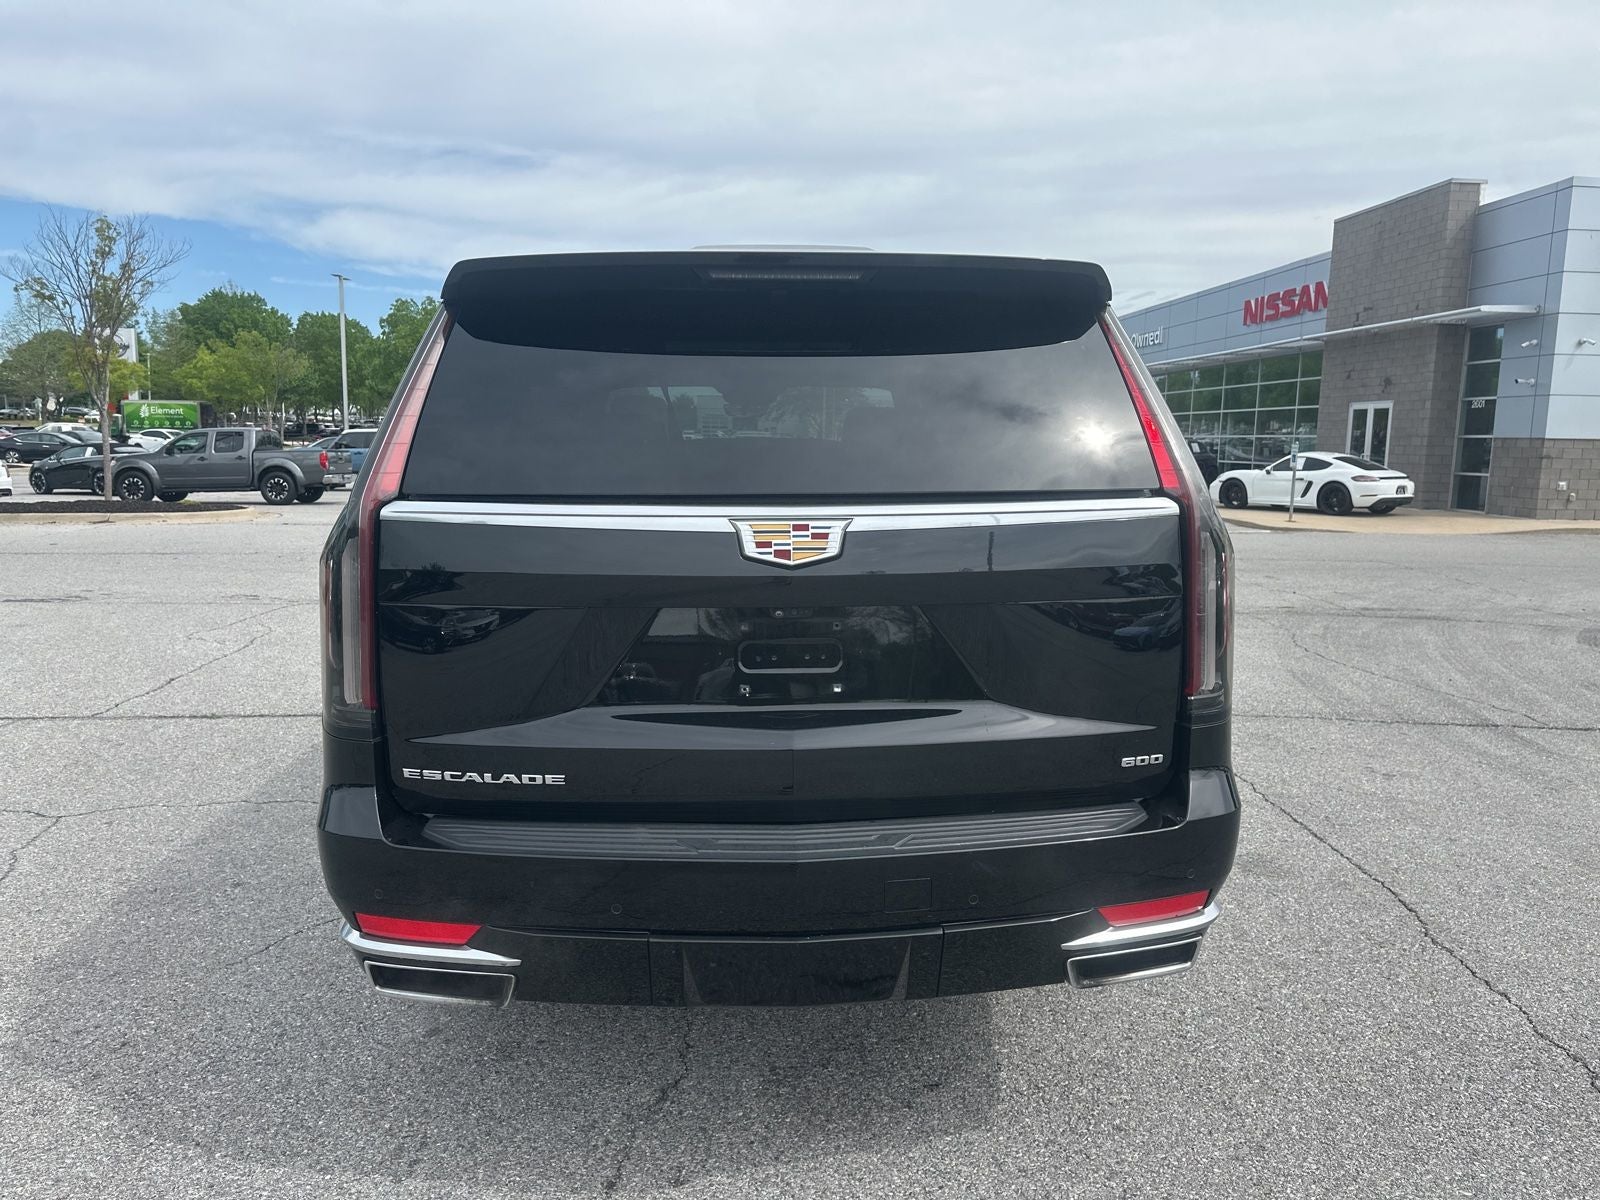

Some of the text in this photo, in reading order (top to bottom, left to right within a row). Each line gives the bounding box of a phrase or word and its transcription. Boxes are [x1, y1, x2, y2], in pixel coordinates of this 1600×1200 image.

[1243, 281, 1328, 325] NISSAN
[150, 406, 184, 415] Element
[1121, 754, 1164, 767] 600
[402, 767, 566, 785] ESCALADE
